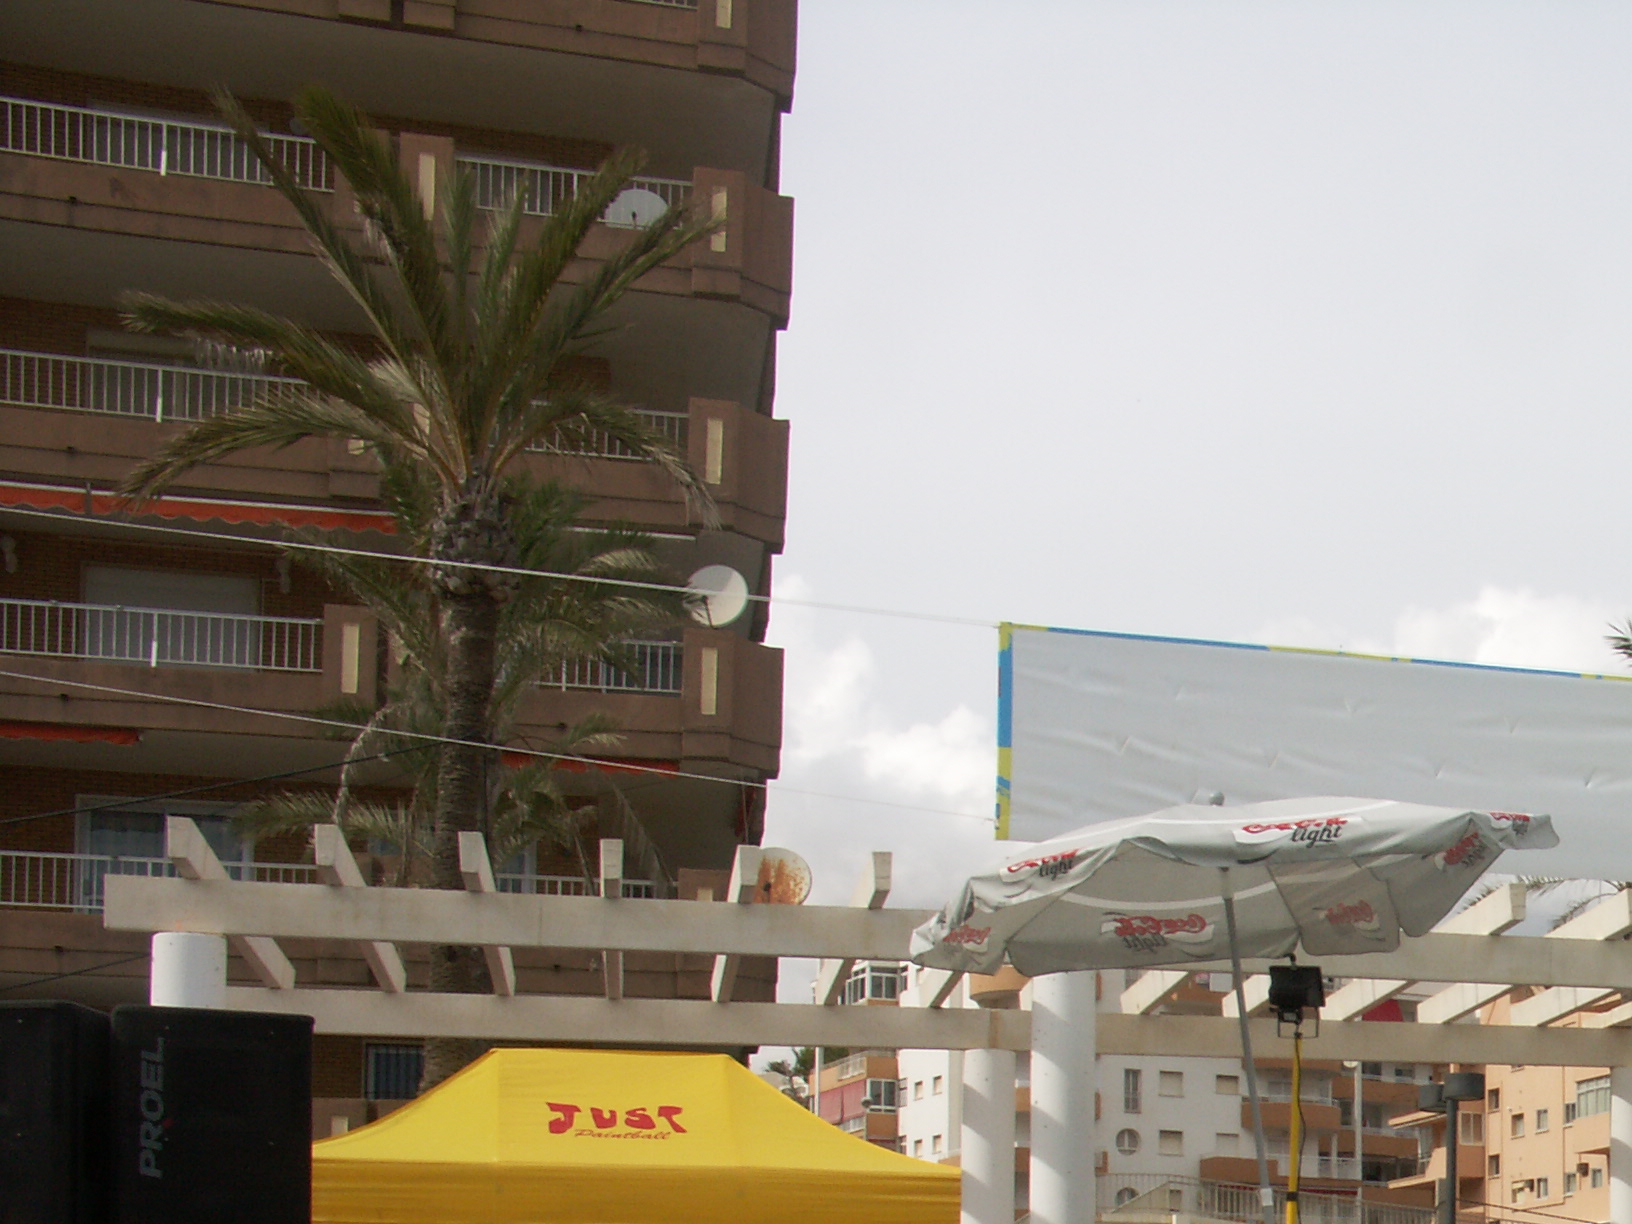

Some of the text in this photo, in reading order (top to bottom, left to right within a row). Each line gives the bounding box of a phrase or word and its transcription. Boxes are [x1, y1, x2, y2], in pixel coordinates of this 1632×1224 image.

[1292, 825, 1342, 848] light
[139, 1037, 165, 1180] PROEL
[546, 1102, 688, 1134] JUST
[575, 1129, 672, 1140] Paintball
